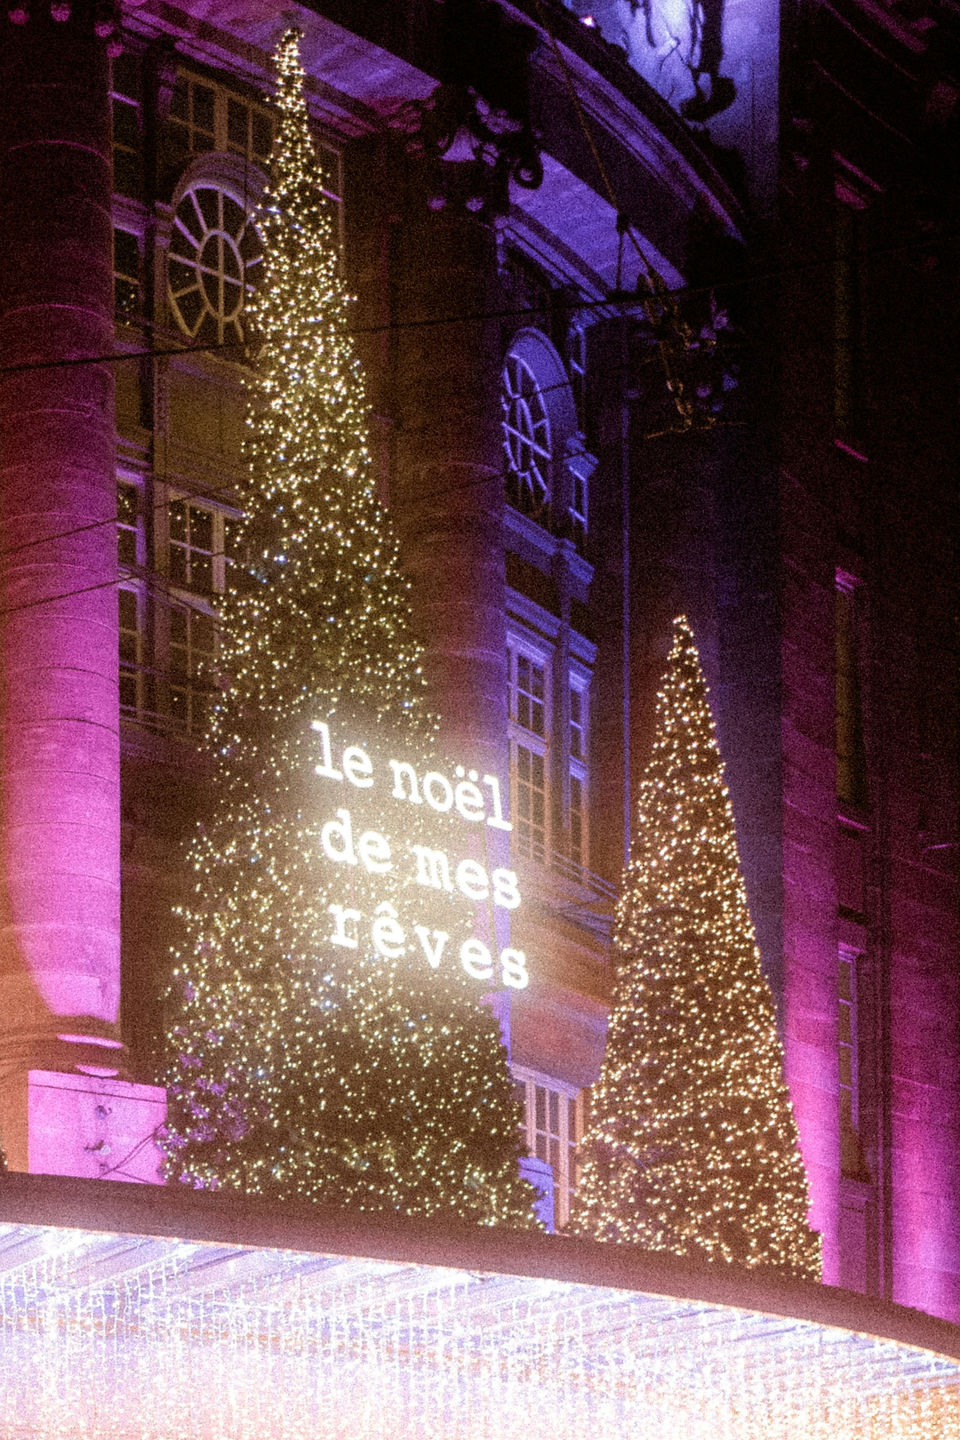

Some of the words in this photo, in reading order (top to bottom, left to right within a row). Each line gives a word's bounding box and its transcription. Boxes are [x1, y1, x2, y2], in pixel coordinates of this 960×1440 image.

[310, 720, 374, 788] le
[389, 758, 513, 831] noël
[321, 808, 391, 873] de
[411, 844, 521, 910] mes
[329, 901, 529, 989] rêves
